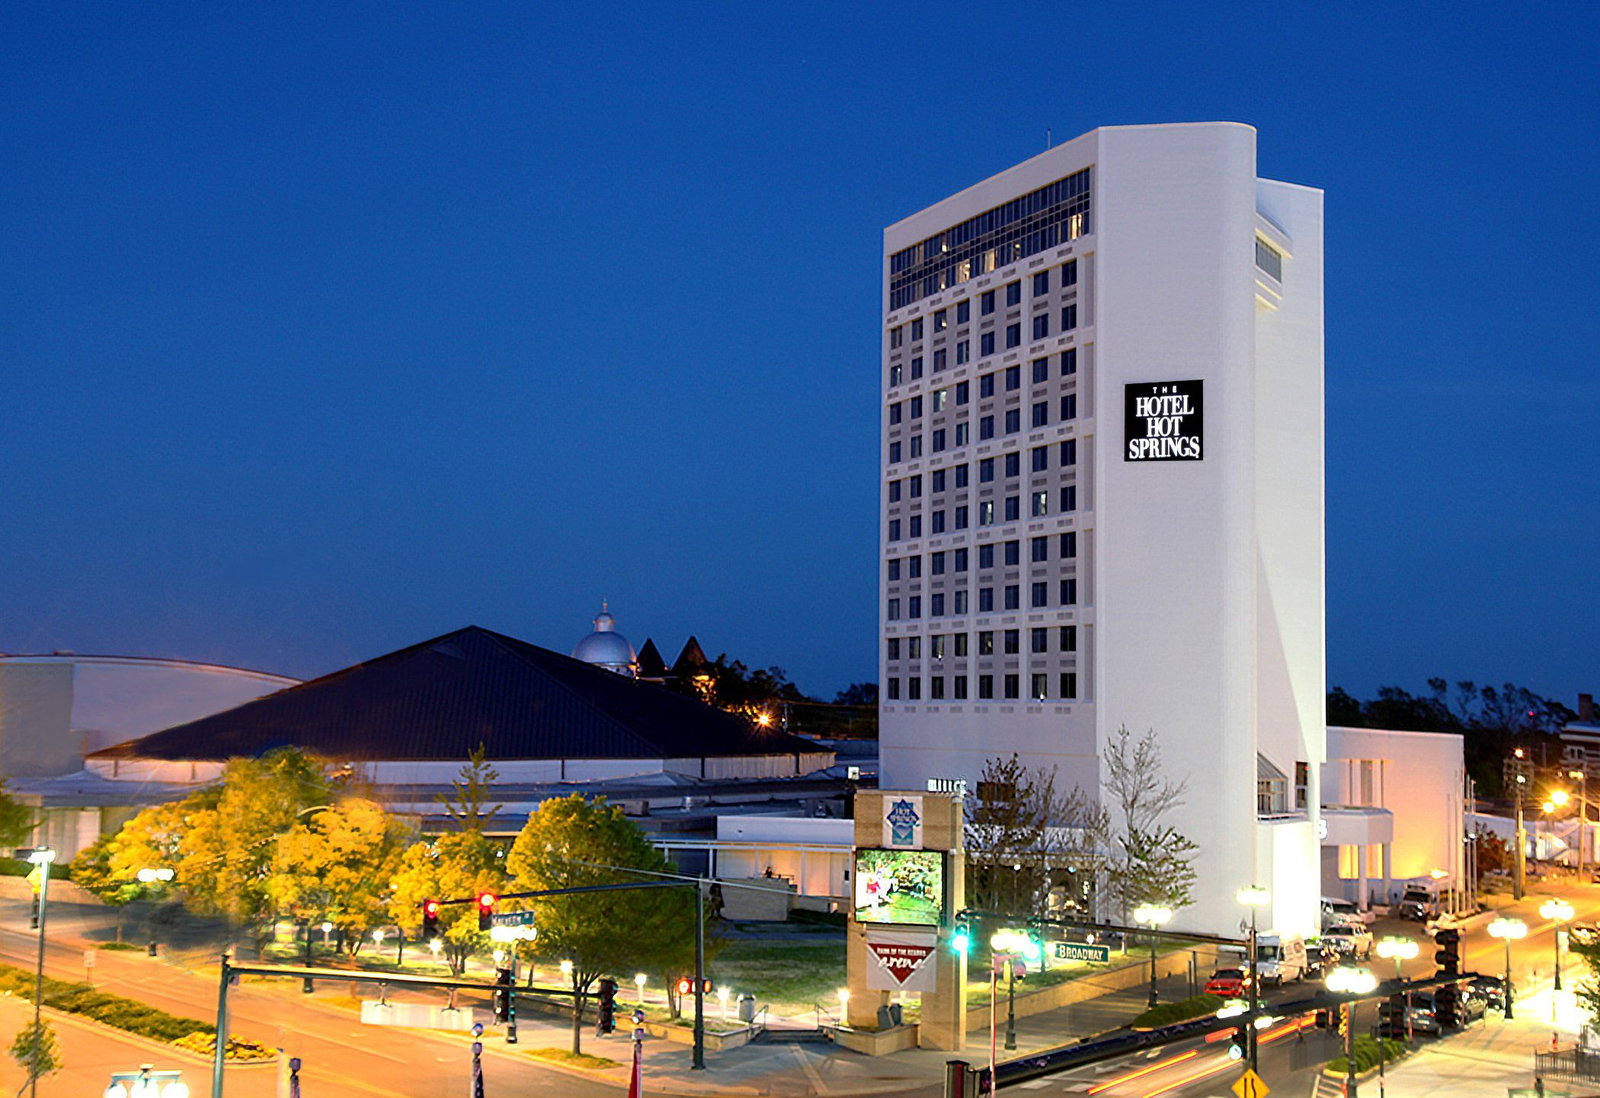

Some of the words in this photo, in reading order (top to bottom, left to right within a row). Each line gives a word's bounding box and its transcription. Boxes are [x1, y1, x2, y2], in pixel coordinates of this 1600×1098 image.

[1153, 385, 1177, 394] THE
[1136, 395, 1194, 417] HOTEL
[1146, 416, 1183, 437] HOT
[1129, 436, 1200, 459] SPRINGS
[1059, 945, 1103, 961] BROADWAY
